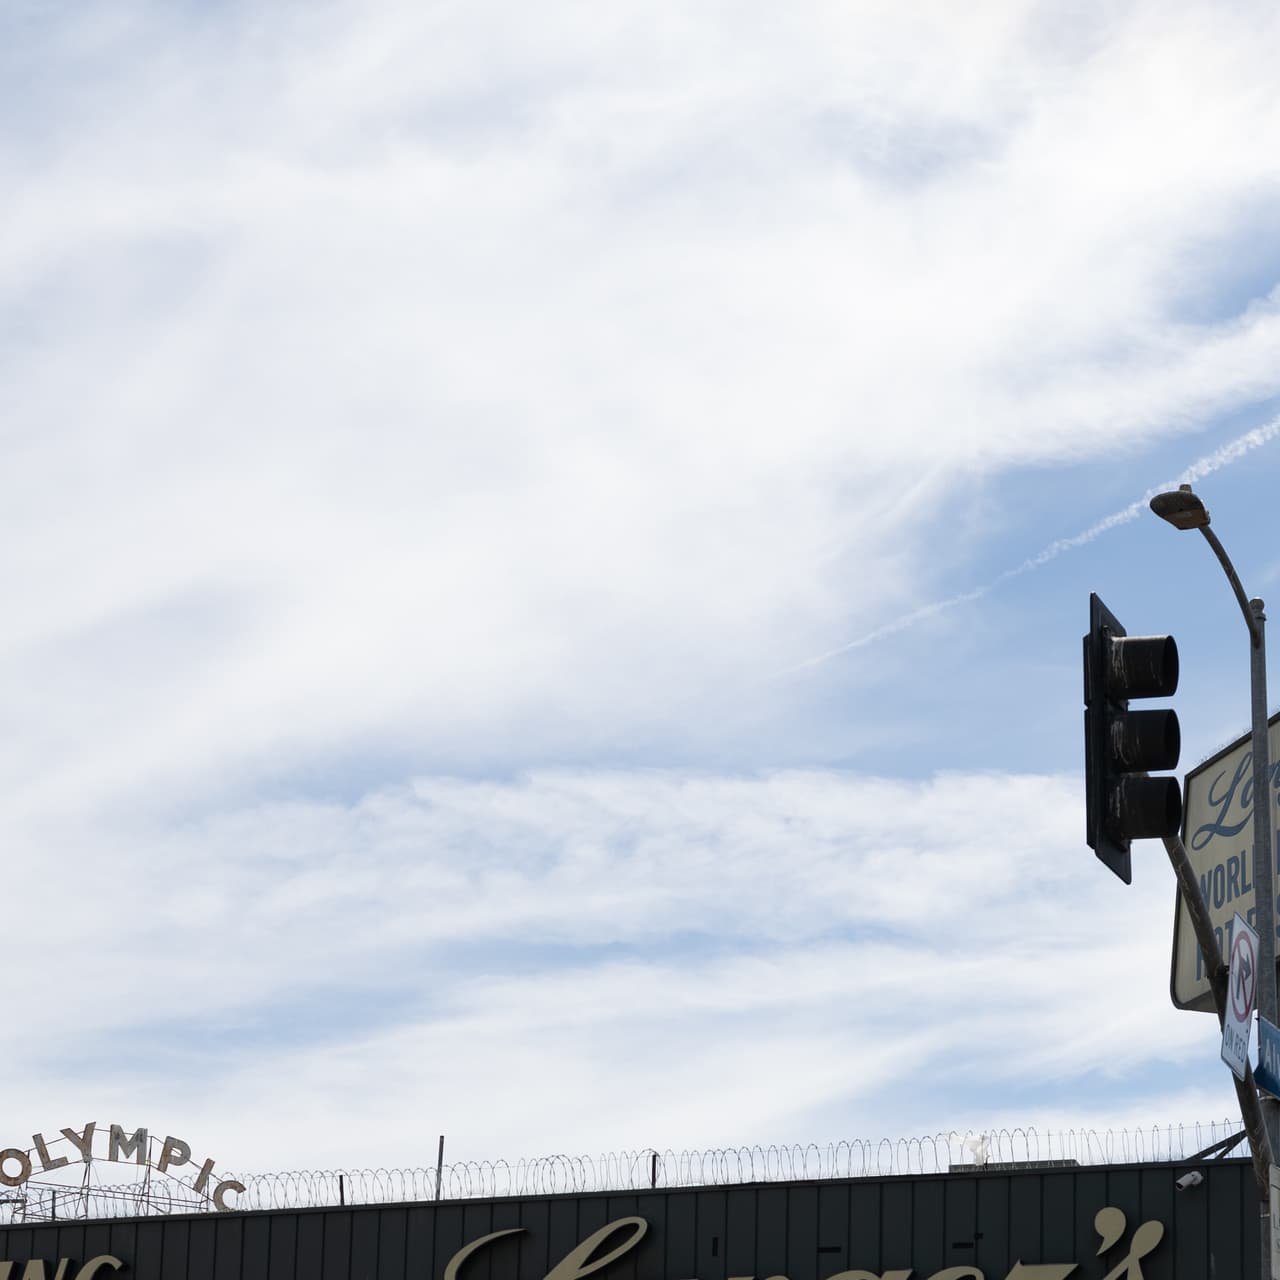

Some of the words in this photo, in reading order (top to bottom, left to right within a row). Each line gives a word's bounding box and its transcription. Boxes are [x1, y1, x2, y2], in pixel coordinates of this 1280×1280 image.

[1200, 845, 1257, 912] WORL
[1224, 1023, 1234, 1050] ON
[1234, 1038, 1246, 1063] RED
